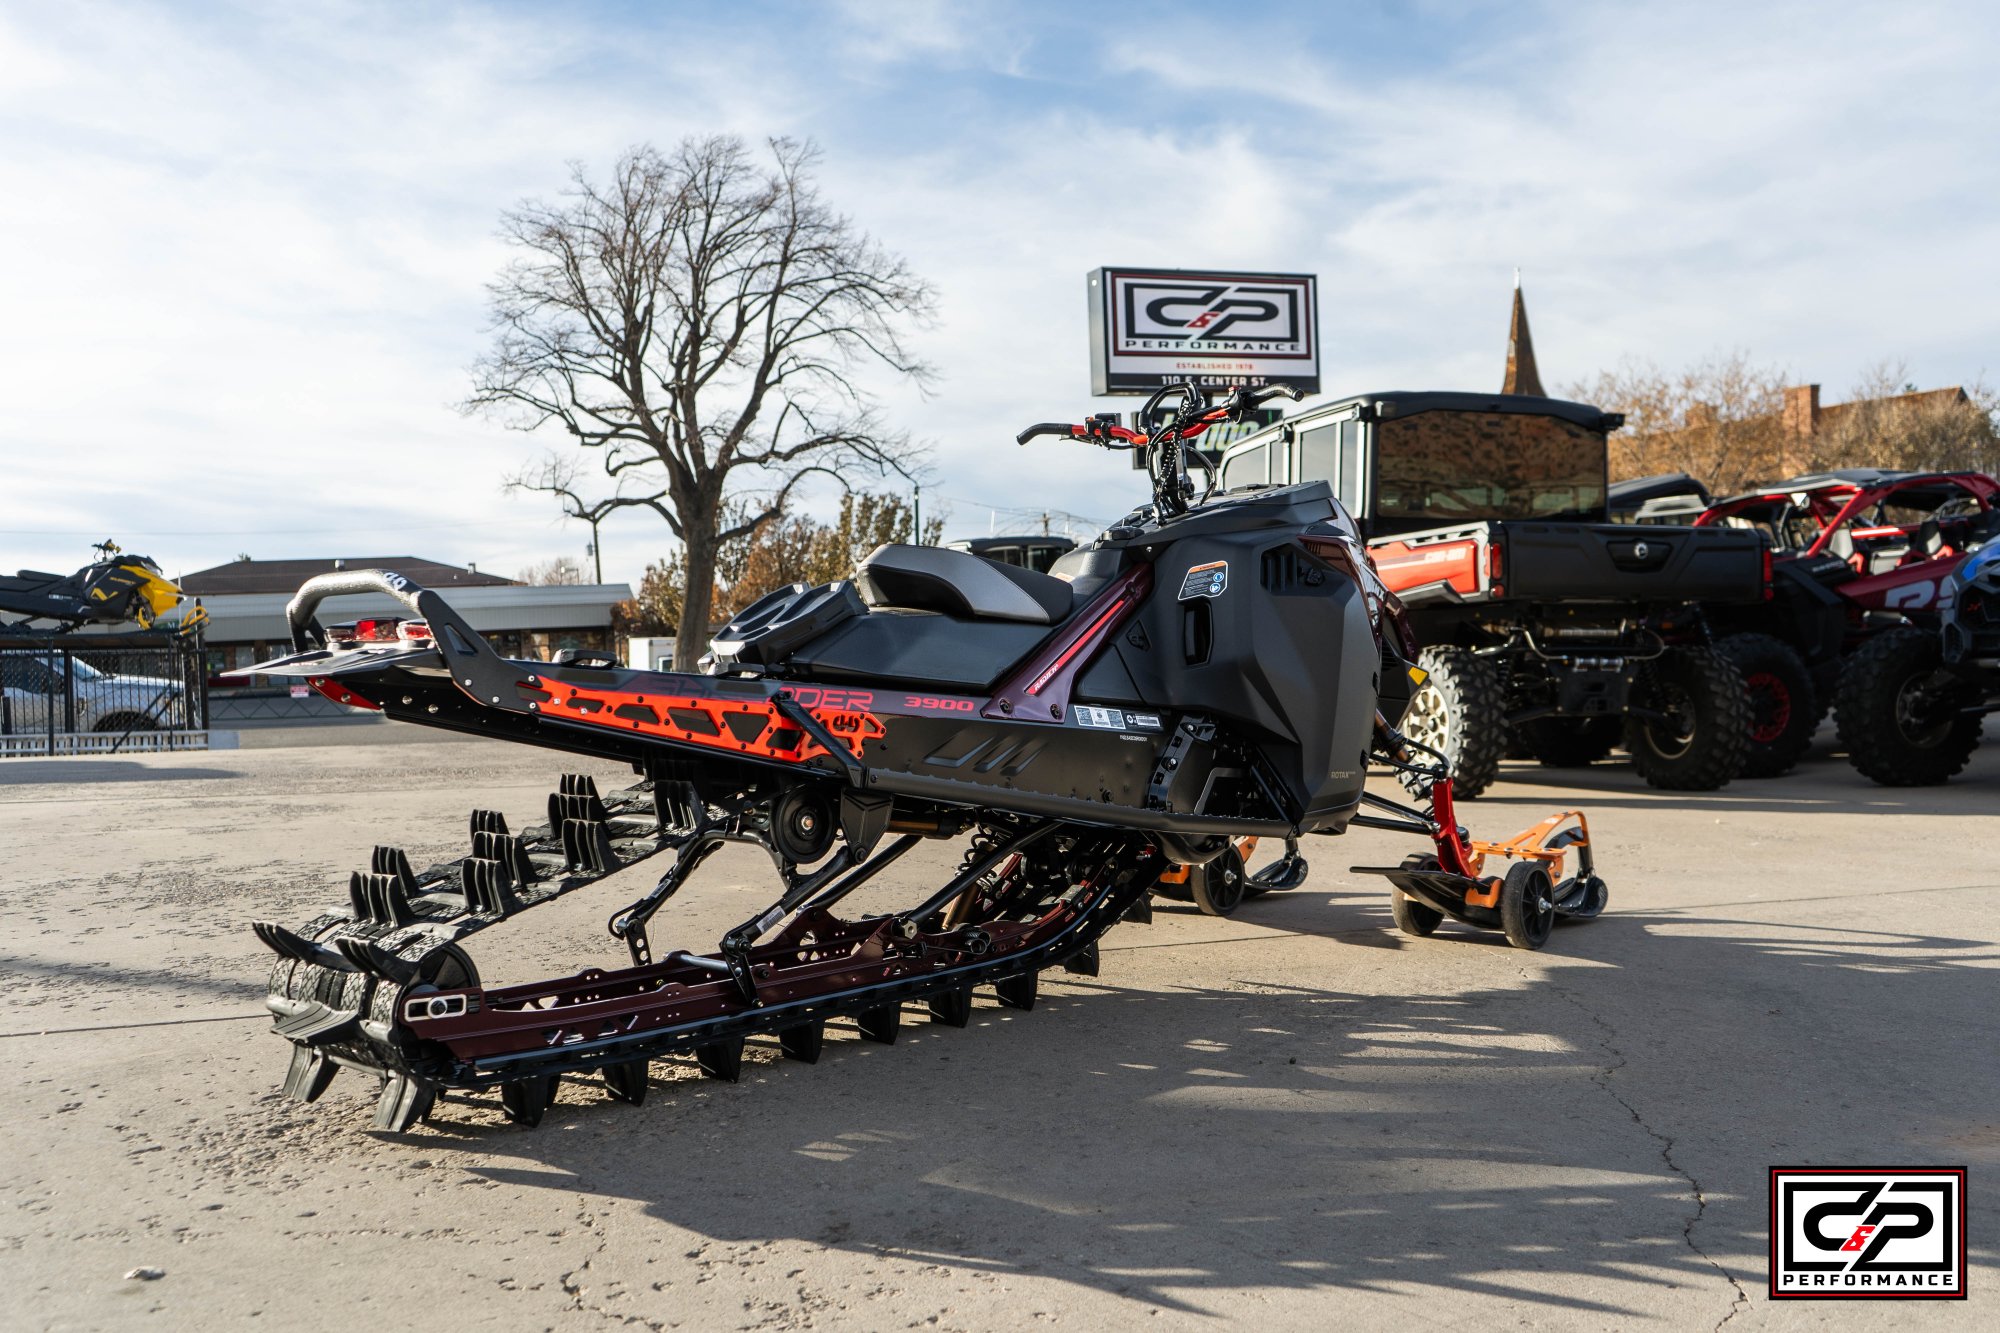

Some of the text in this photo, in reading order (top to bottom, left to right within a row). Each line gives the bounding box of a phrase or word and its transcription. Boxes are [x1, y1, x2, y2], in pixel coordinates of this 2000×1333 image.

[1125, 340, 1299, 351] PERFORMANCE
[1161, 375, 1180, 385] 110
[1200, 376, 1247, 386] CENTER
[1250, 377, 1269, 386] ST.
[904, 696, 974, 711] 3900
